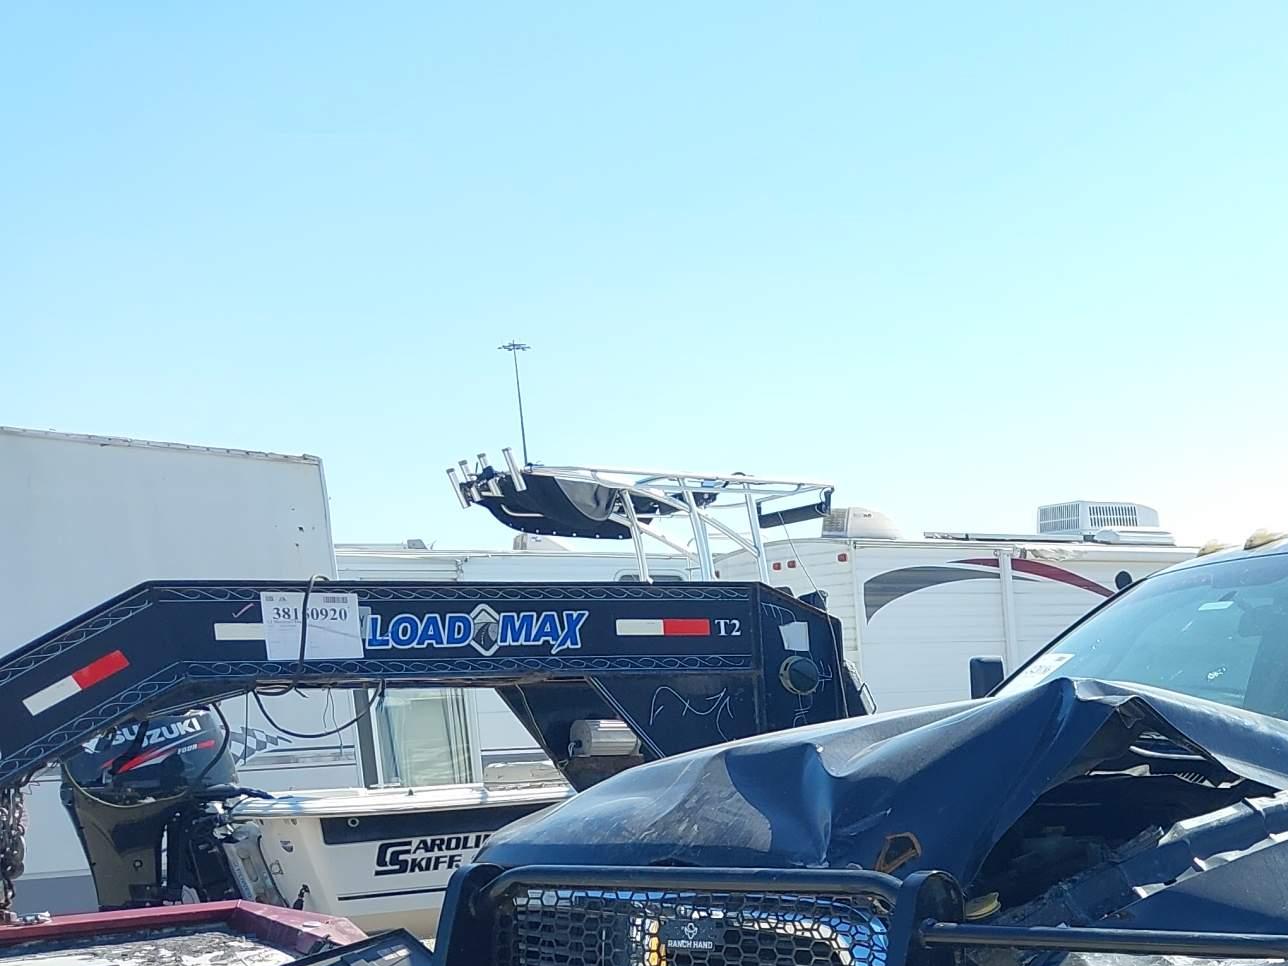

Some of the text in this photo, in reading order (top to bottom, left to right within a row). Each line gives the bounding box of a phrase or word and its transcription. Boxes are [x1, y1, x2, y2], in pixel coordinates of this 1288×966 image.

[366, 610, 589, 655] LOAD MAX
[714, 619, 742, 636] T2
[111, 717, 202, 749] SUZUKI
[667, 939, 713, 949] RANCH HAND
